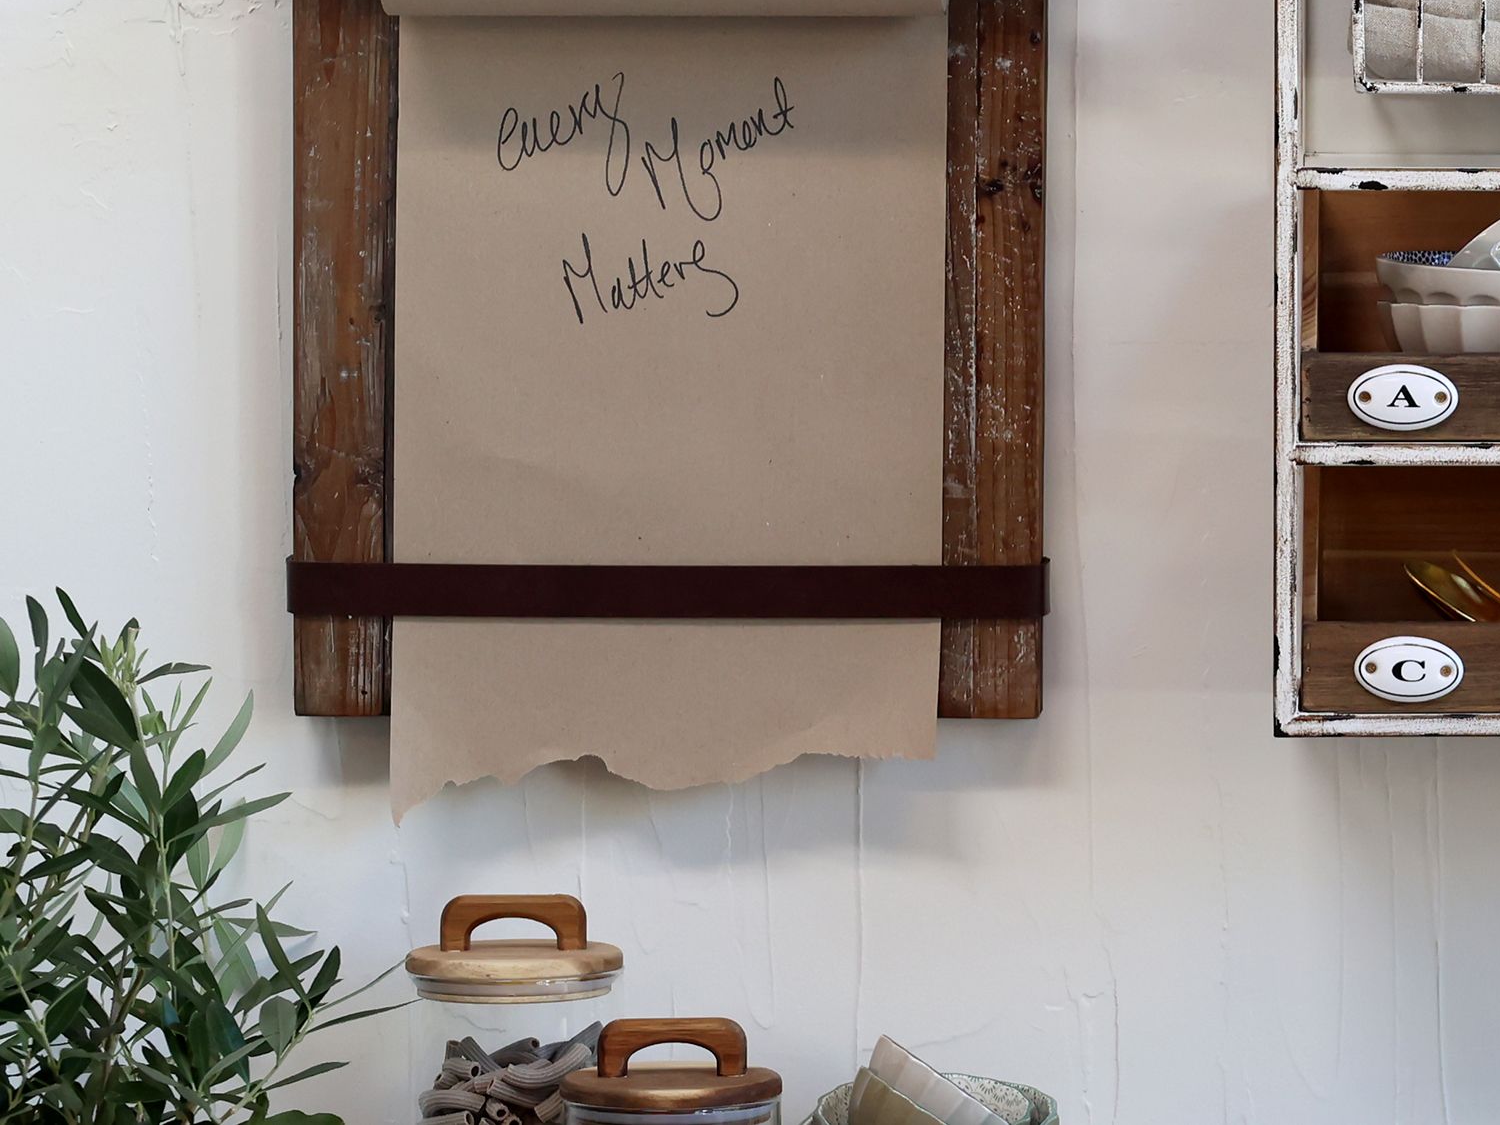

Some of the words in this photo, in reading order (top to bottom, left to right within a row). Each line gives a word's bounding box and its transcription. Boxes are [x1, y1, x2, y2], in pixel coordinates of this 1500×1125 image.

[641, 76, 796, 222] Moment
[562, 232, 739, 325] Matters
[1386, 383, 1421, 409] A
[1391, 659, 1427, 683] C
